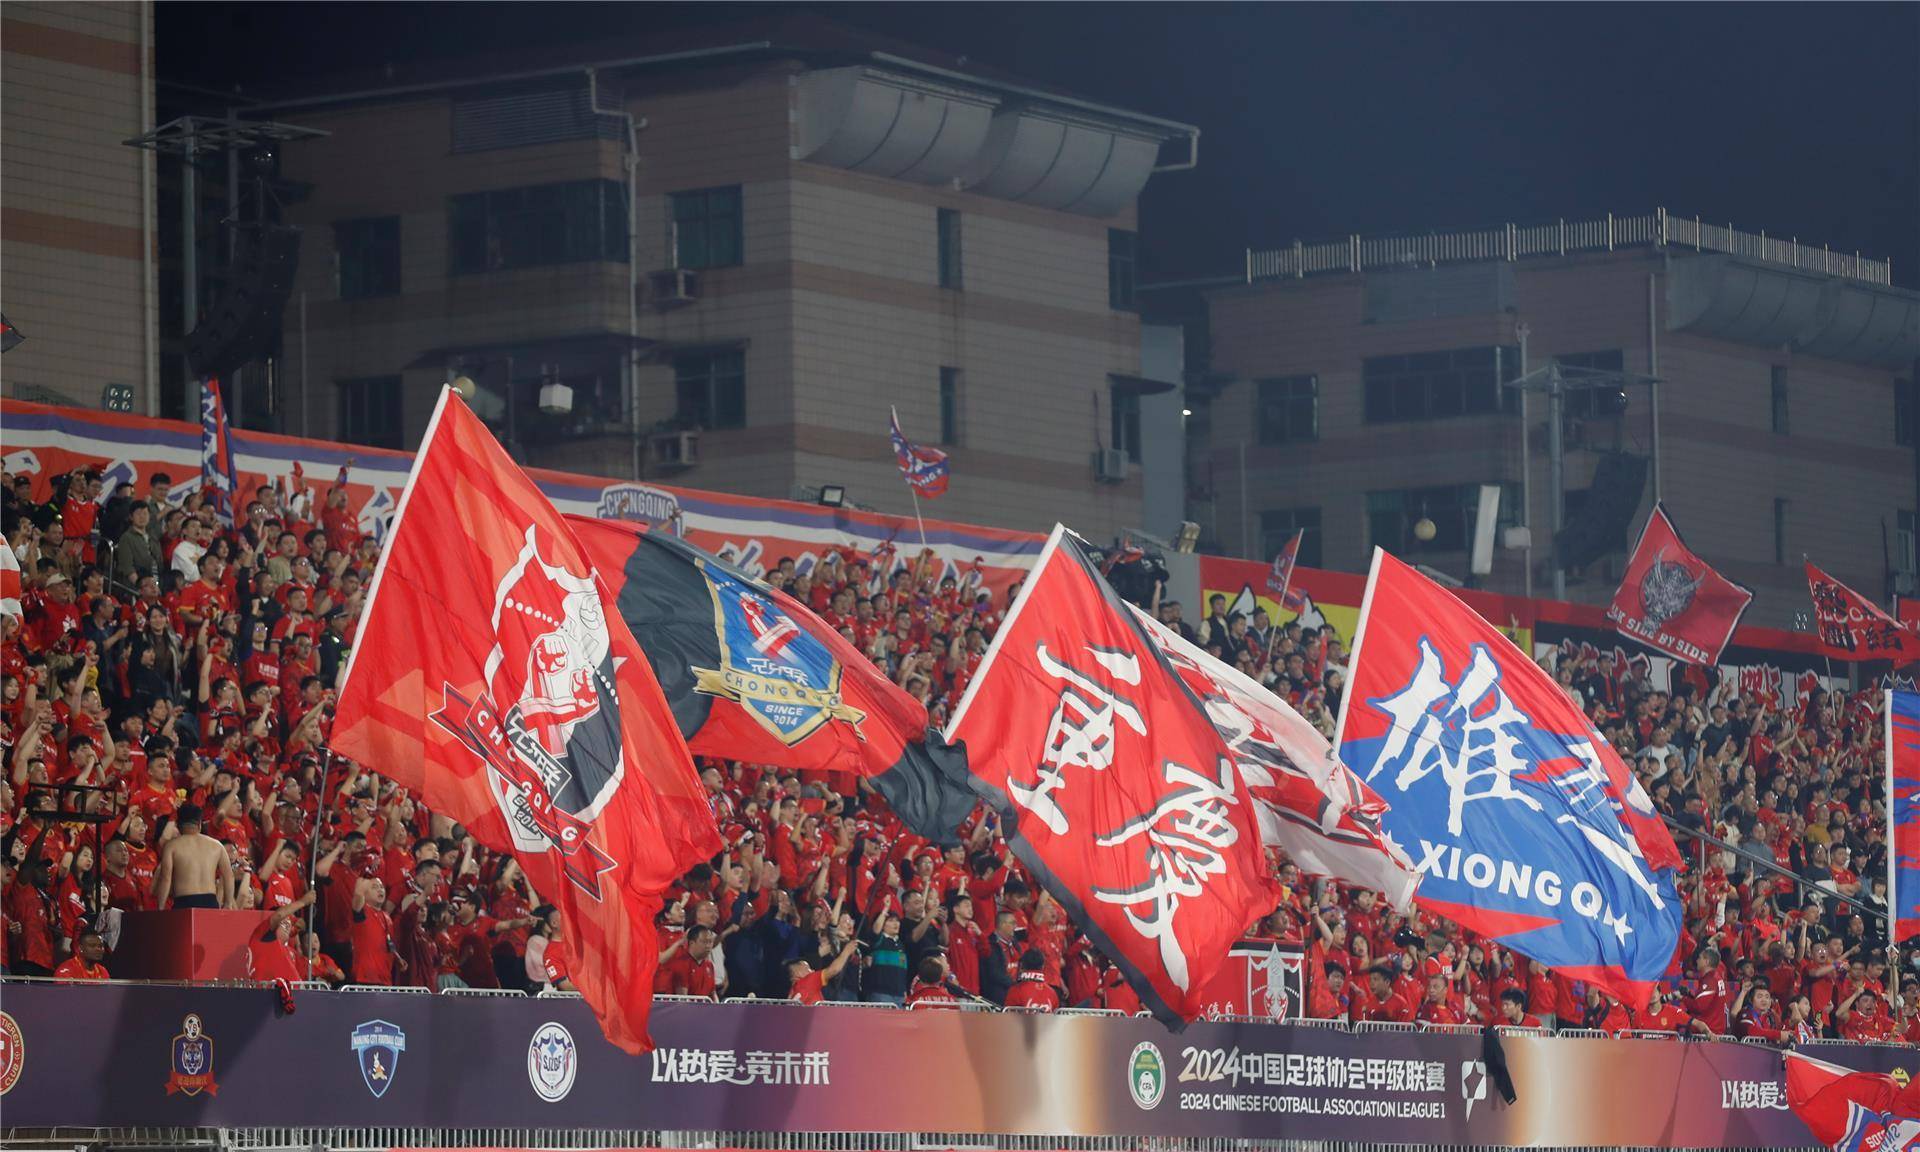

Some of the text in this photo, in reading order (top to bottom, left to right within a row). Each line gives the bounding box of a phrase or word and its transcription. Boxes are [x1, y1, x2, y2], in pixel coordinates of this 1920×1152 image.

[1658, 633, 1675, 648] BY
[1676, 639, 1709, 664] SIDE
[765, 704, 805, 717] SINCE
[773, 714, 798, 727] 2014
[1415, 839, 1562, 907] XIONG
[1142, 1082, 1152, 1090] CFA
[1180, 1093, 1211, 1111] 2024
[1213, 1094, 1261, 1112] CHINESE
[1263, 1096, 1321, 1114] FOOTBALL
[1323, 1098, 1396, 1118] ASSOCIATION
